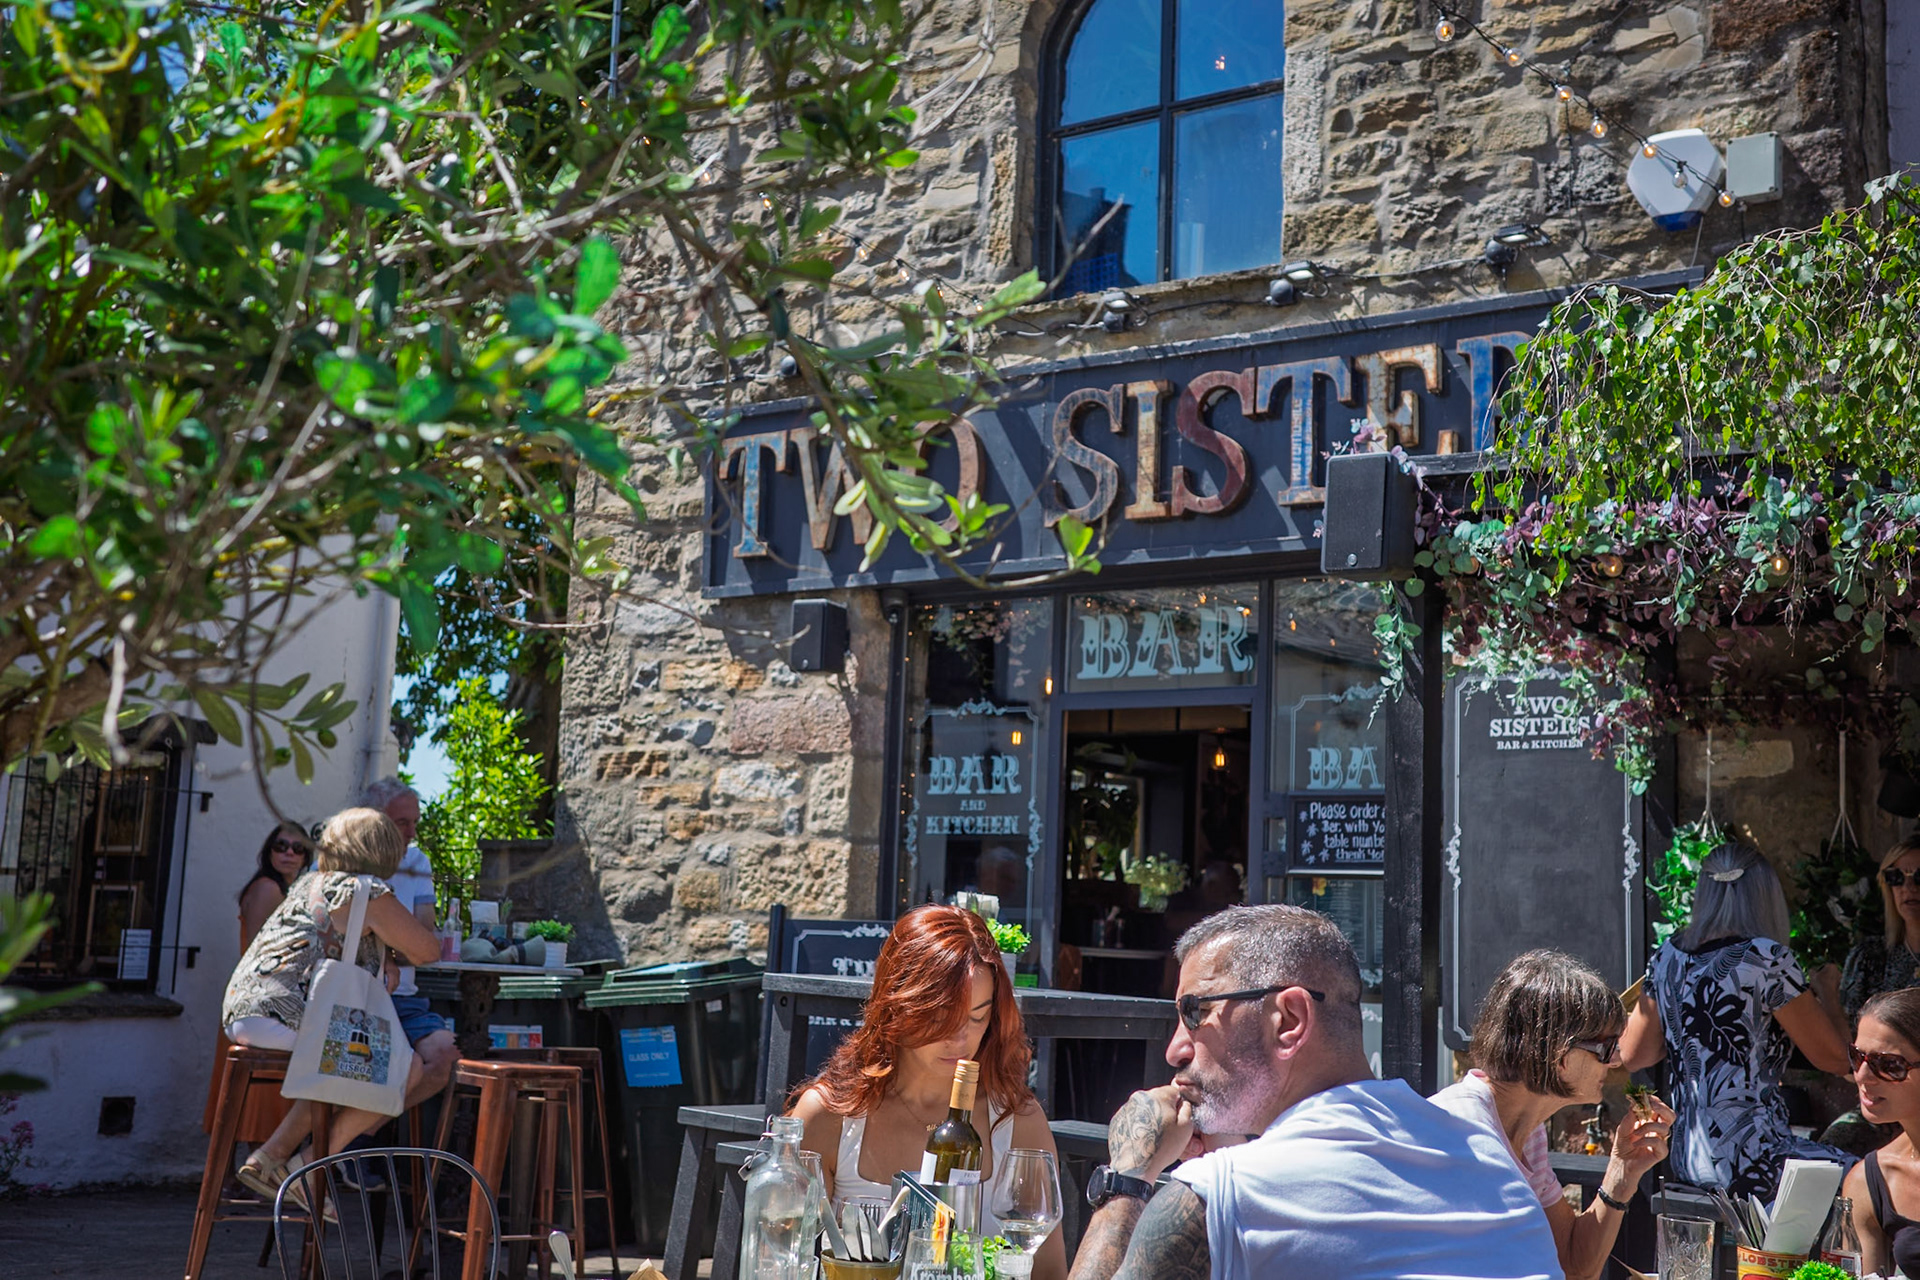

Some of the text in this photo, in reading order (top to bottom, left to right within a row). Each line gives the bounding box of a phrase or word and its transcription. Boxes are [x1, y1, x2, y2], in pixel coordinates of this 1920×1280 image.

[1076, 601, 1253, 679] BAR
[1510, 695, 1569, 716] TWO
[1489, 716, 1590, 738] SISTERS
[1496, 739, 1584, 750] BAR & KITCHEN
[926, 752, 1022, 795] BAR
[960, 799, 987, 811] AND
[1310, 802, 1347, 819] Please
[1350, 802, 1380, 819] order
[925, 815, 1020, 835] KITCHEN
[1345, 819, 1369, 833] with
[1324, 833, 1350, 849] table
[1336, 848, 1366, 860] thank
[629, 1052, 669, 1061] GLASS ONLY
